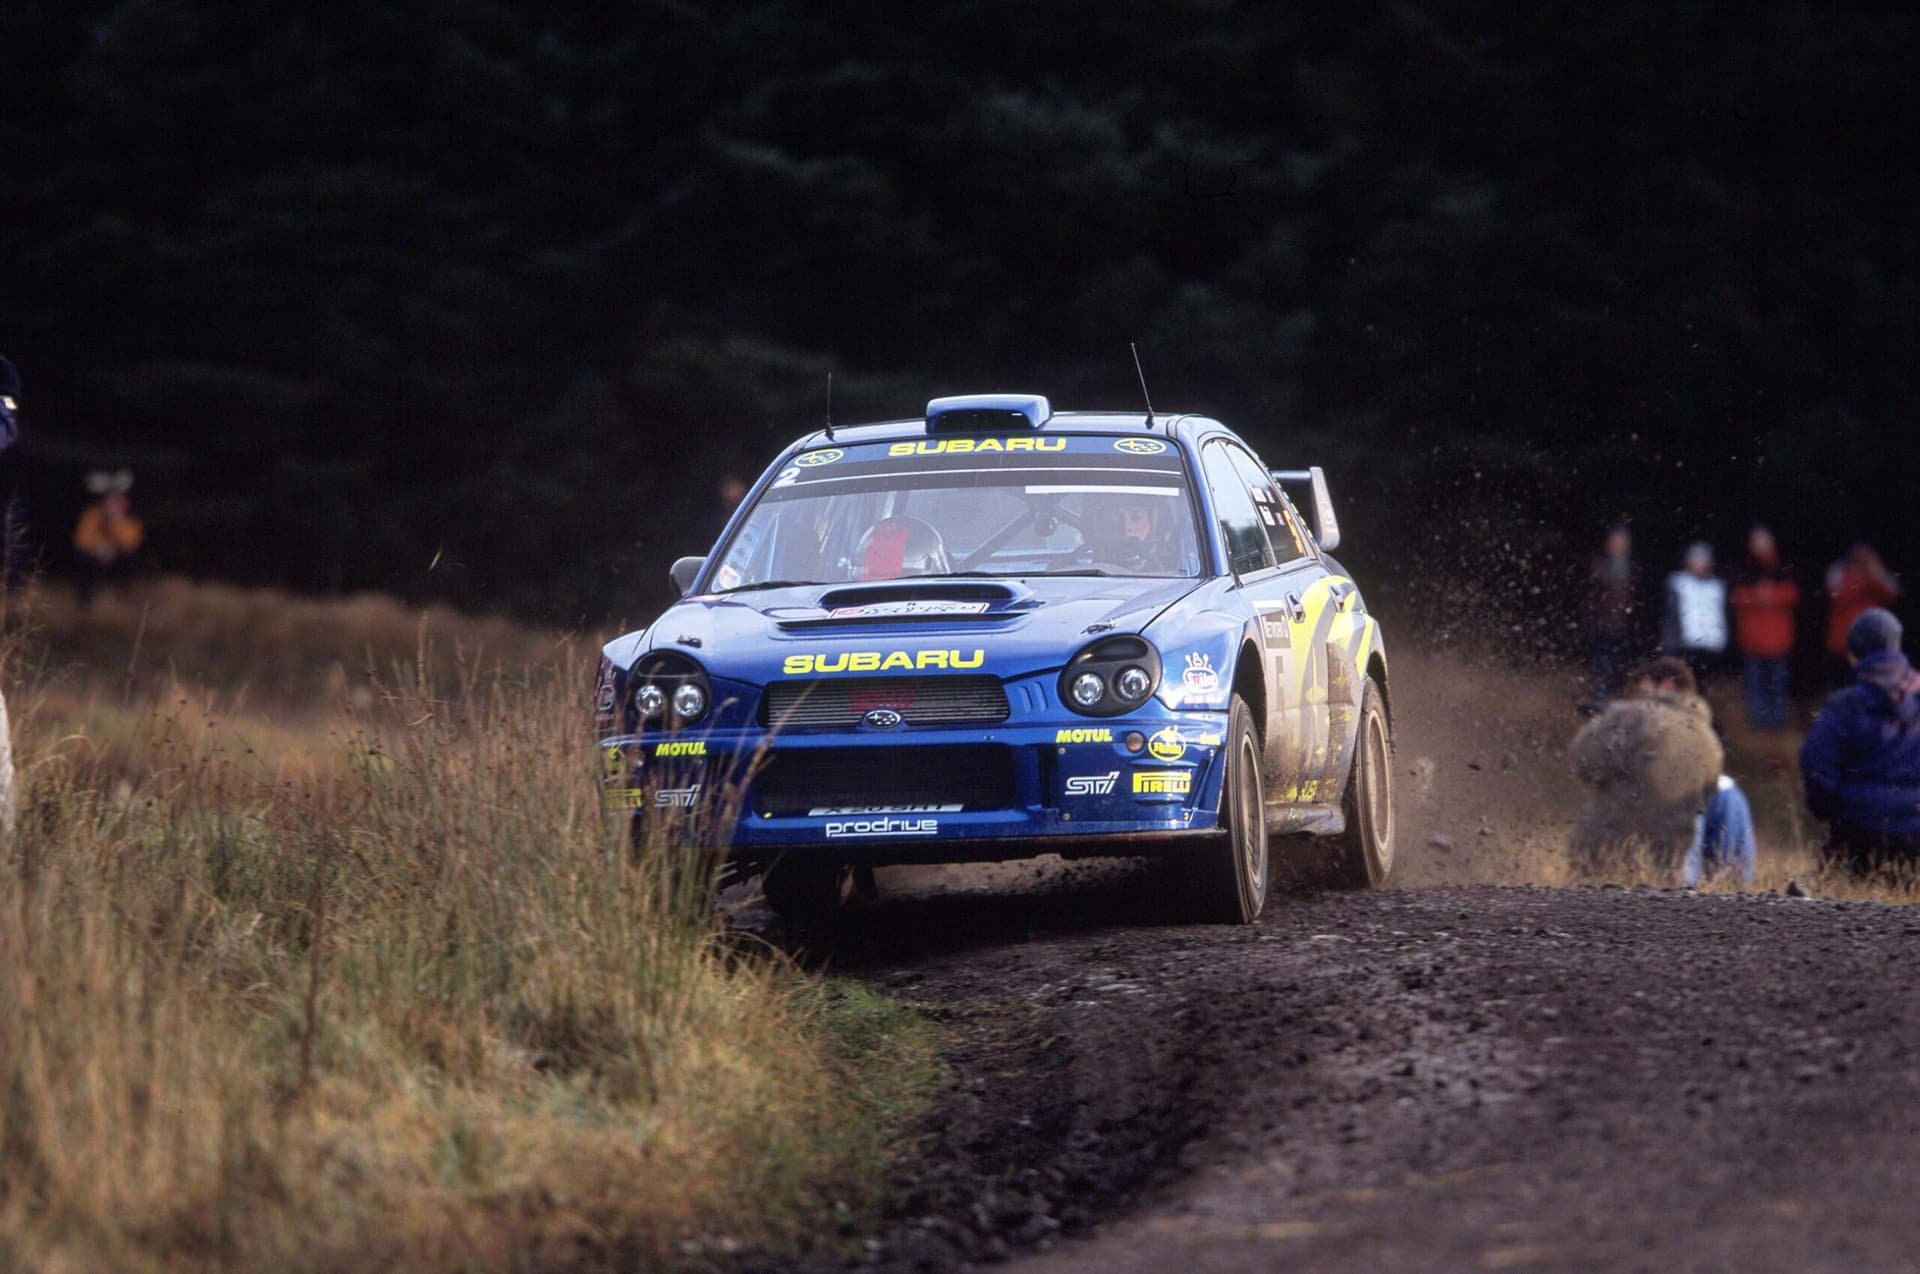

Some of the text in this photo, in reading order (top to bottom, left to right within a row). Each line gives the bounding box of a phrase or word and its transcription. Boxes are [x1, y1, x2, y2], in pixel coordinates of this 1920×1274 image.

[888, 437, 1067, 457] SUBARU
[782, 649, 985, 675] SUBARU
[1055, 728, 1113, 744] MOTUL
[655, 741, 708, 757] MOTUL
[1131, 771, 1192, 794] PIRELLI
[825, 816, 938, 837] prodrive
